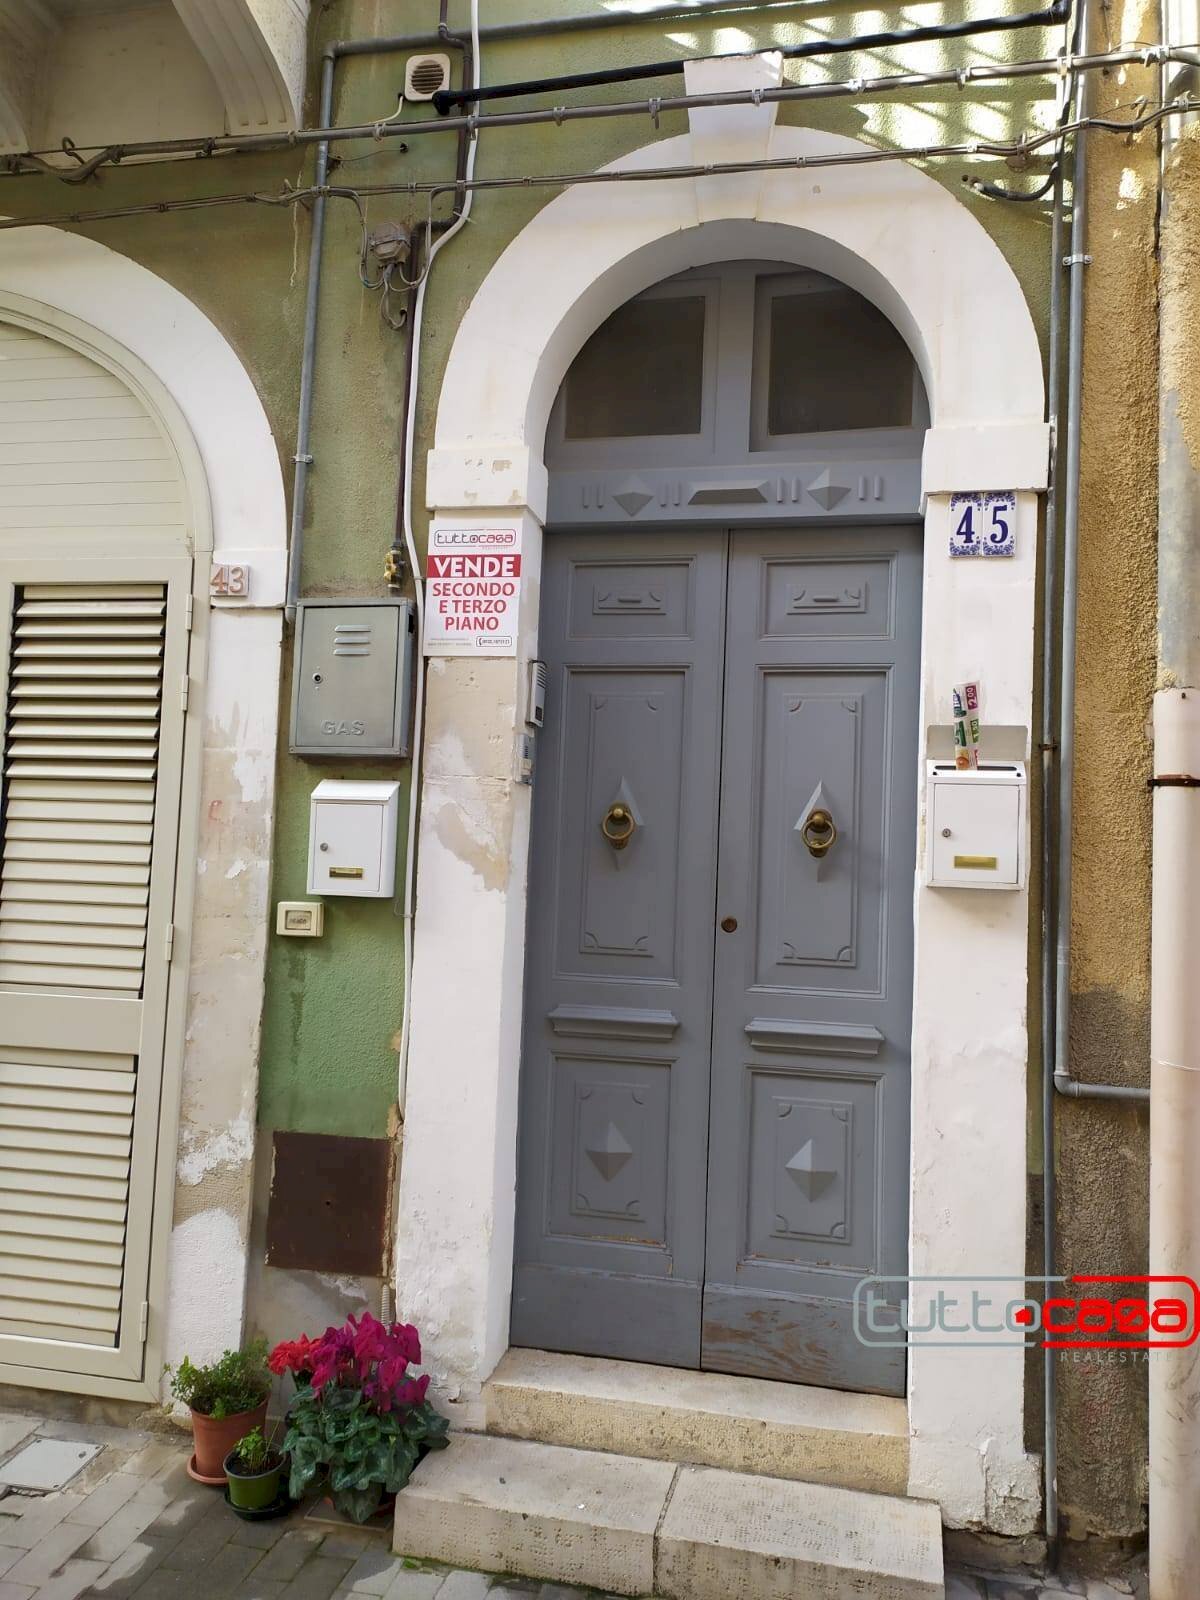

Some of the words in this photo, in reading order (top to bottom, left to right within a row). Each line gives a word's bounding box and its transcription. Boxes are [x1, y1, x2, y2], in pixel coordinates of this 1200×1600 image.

[956, 505, 1009, 544] 45
[437, 533, 513, 543] tuttocasa
[434, 556, 514, 576] VENDE
[210, 567, 244, 594] 43
[432, 582, 515, 597] SECONDO
[439, 600, 448, 614] E
[452, 599, 507, 614] TERZO
[444, 616, 499, 631] PIANO
[321, 720, 365, 736] GAS
